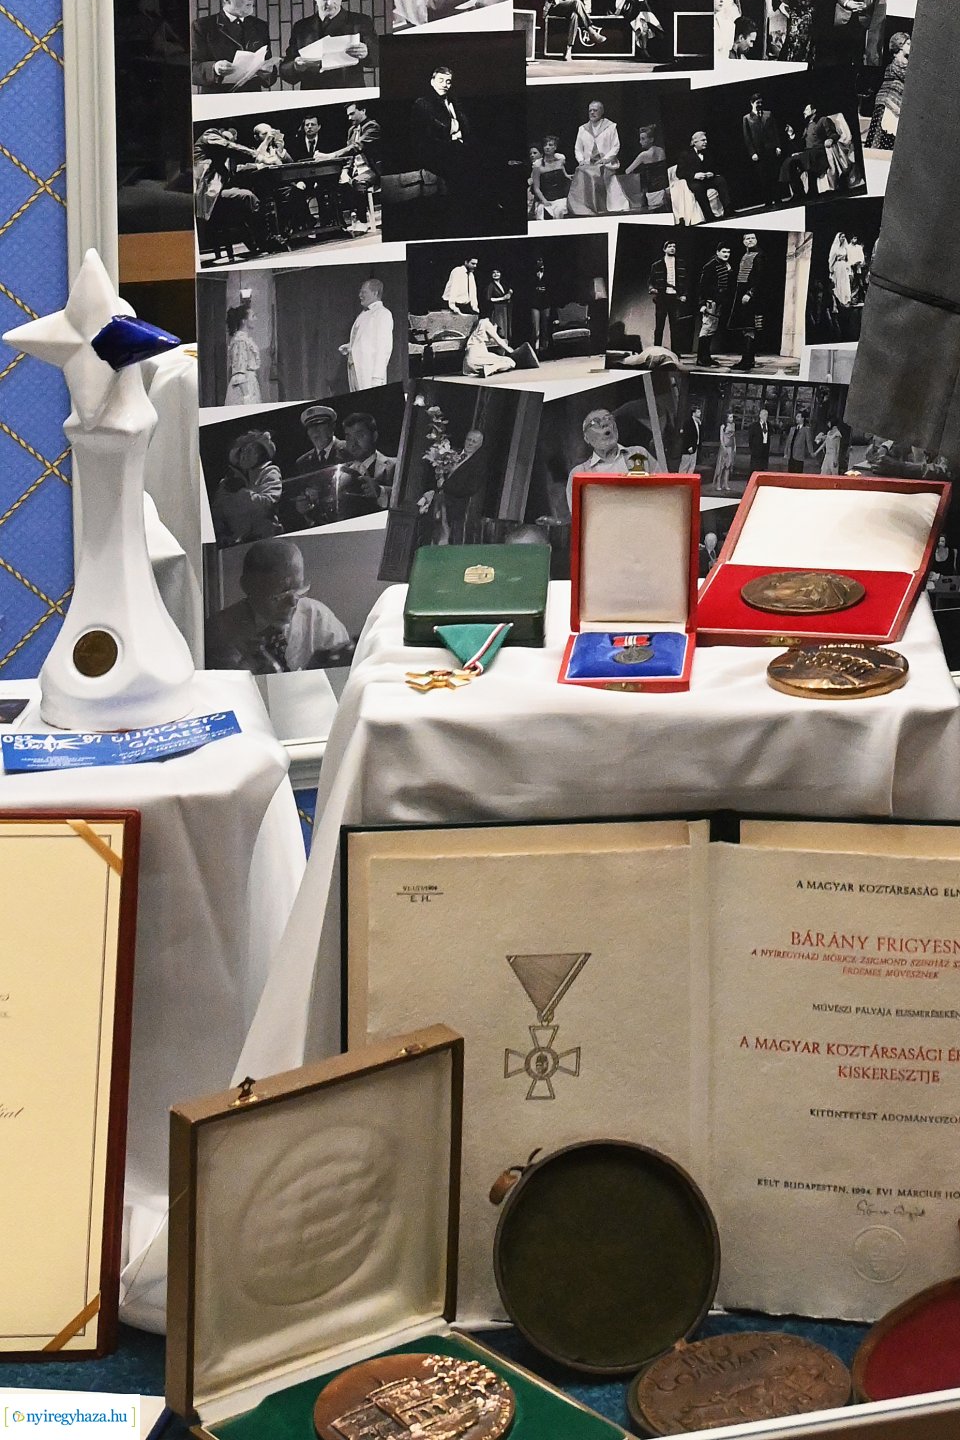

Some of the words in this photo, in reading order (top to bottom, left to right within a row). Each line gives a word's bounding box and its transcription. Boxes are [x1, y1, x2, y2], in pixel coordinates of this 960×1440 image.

[796, 879, 804, 890] A
[806, 880, 854, 894] MAGYAR
[790, 930, 869, 951] BÁRÁNY
[739, 1035, 750, 1049] A
[755, 1036, 821, 1056] MAGYAR
[838, 1065, 940, 1084] KISKERESZTJE
